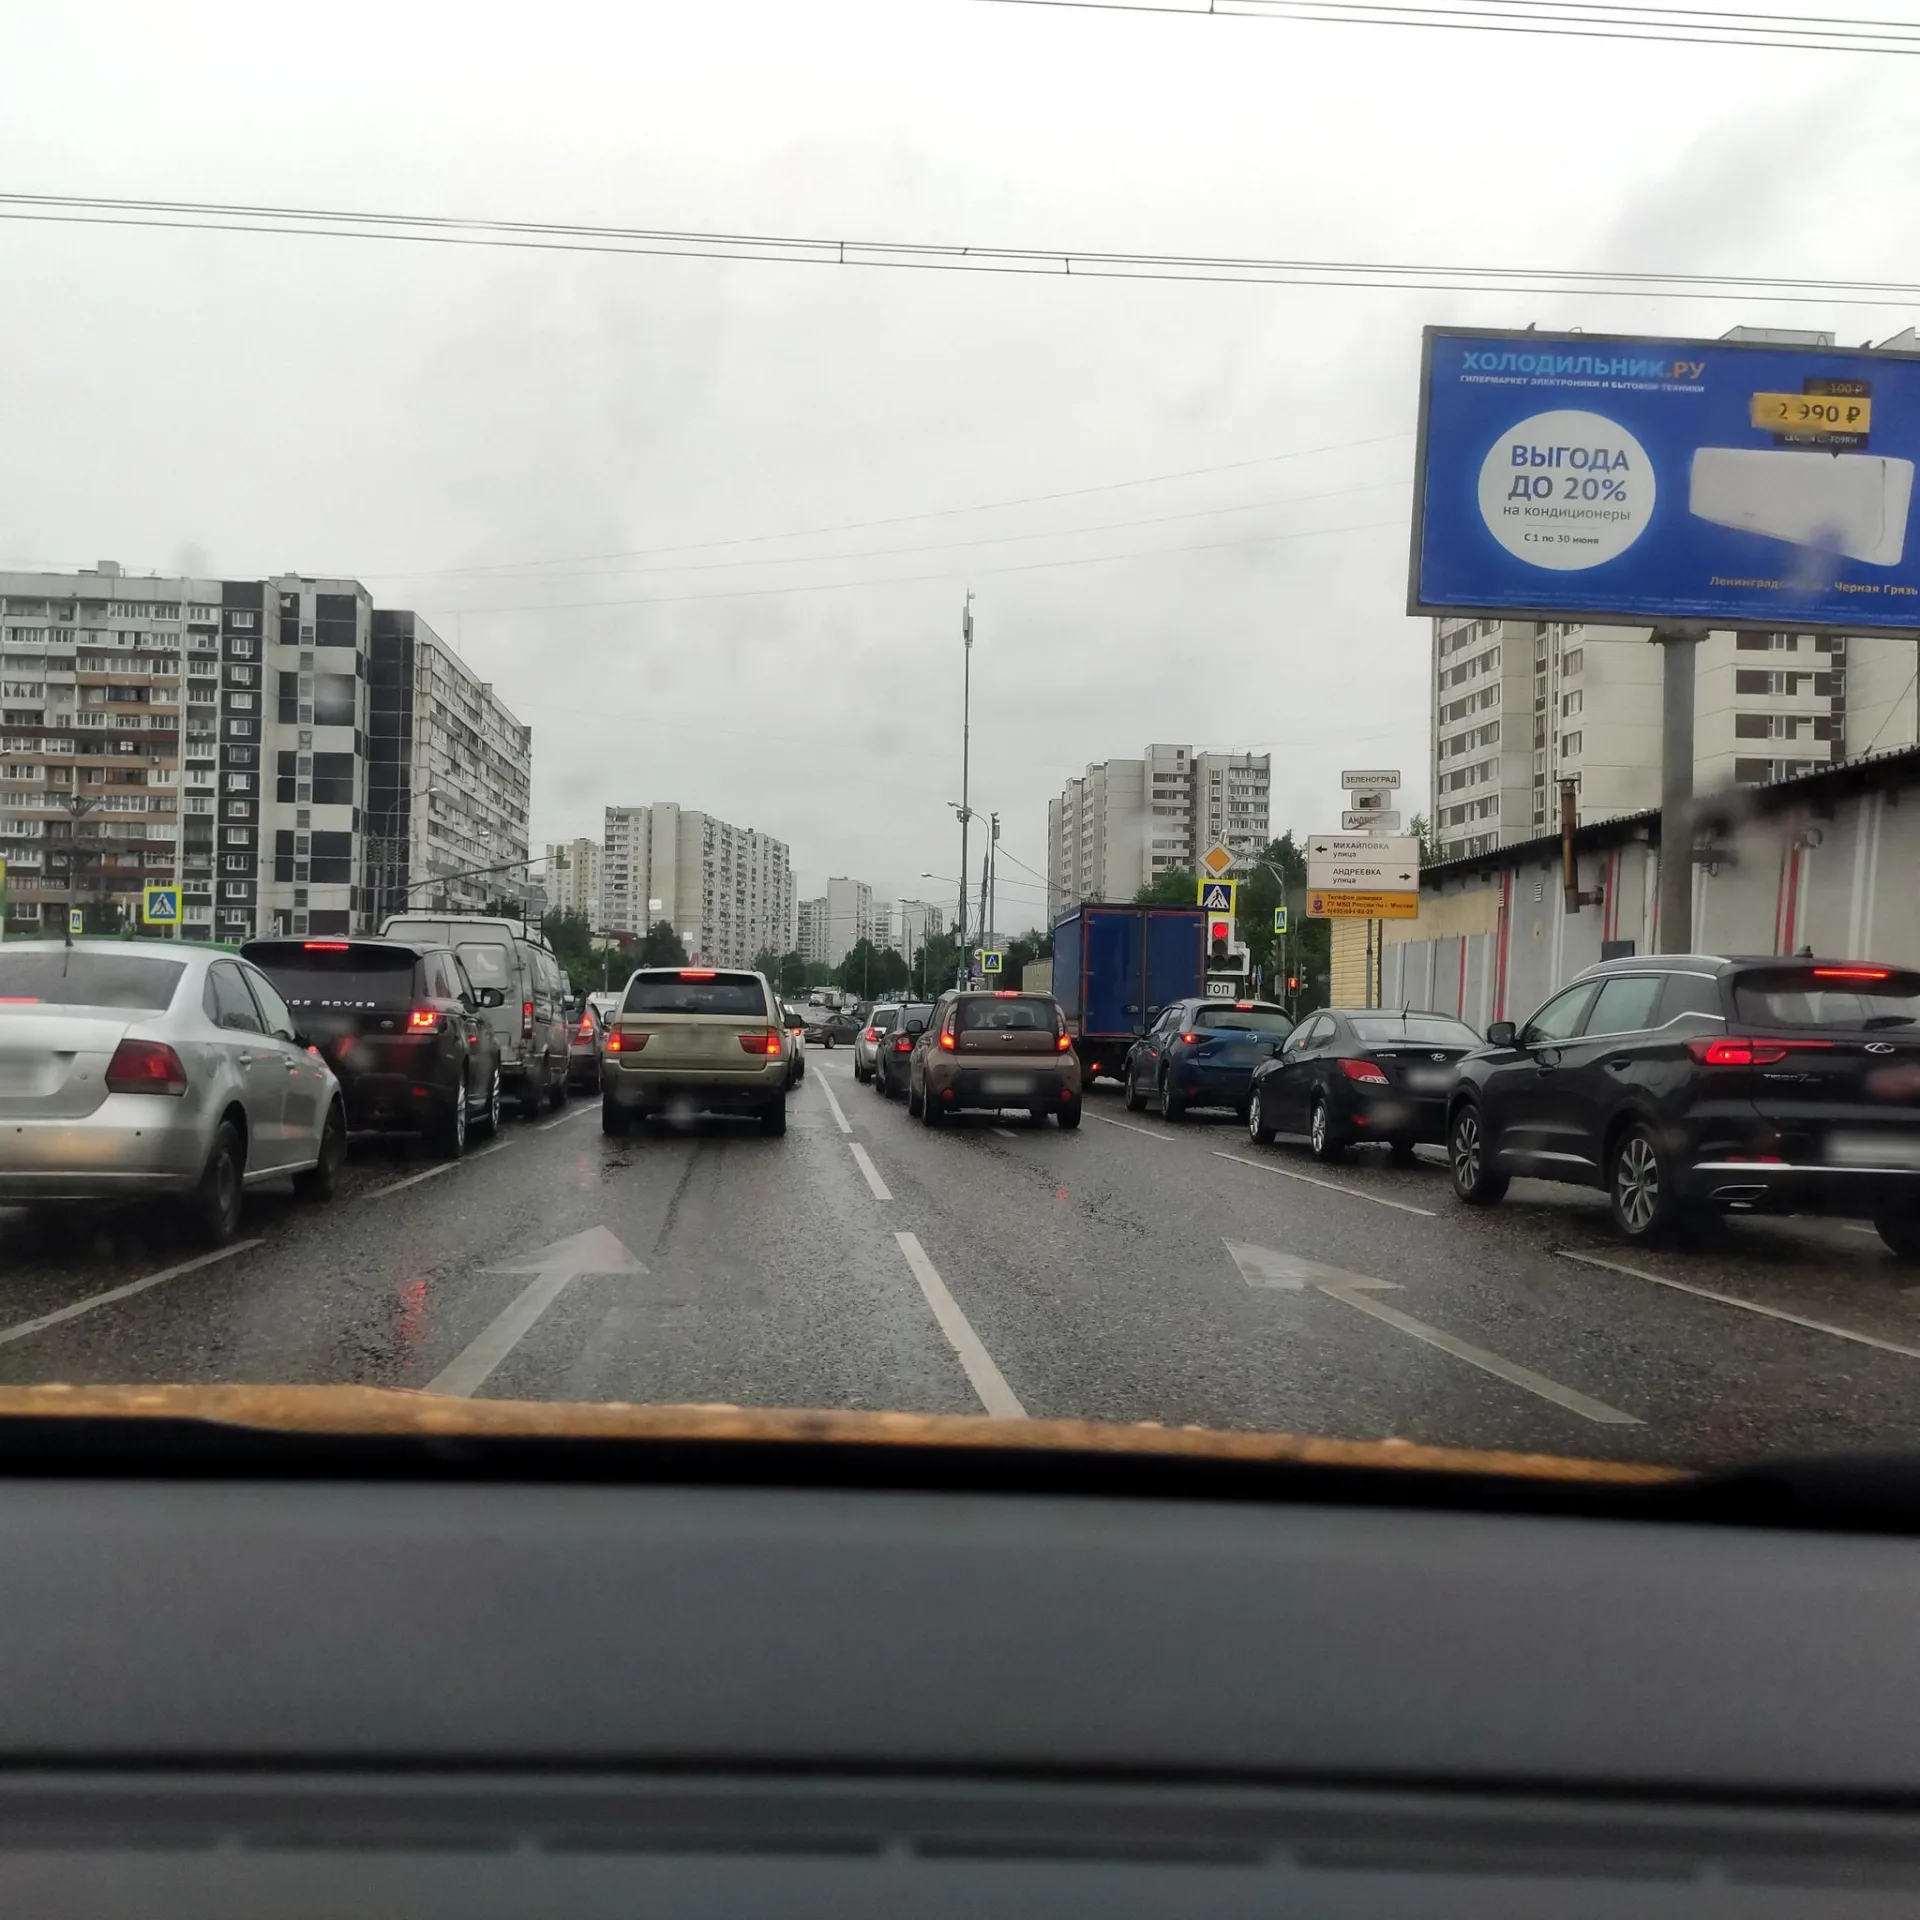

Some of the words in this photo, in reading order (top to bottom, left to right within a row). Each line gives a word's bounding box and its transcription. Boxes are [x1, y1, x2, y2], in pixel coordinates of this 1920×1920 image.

[1463, 352, 1706, 380] ХОЛОДИЛЬНИК.РУ
[1460, 375, 1528, 385] ГИПЕРМАРКЕТ
[1531, 378, 1600, 388] ЭЛЕКТРОНИКИ
[1602, 380, 1609, 388] И
[1799, 404, 1839, 423] 990
[1511, 444, 1630, 473] ВЫГОДА
[1508, 475, 1553, 501] ДО
[1563, 477, 1627, 502] 20%
[1503, 506, 1520, 516] на
[1524, 507, 1631, 522] кондиционеры
[1524, 533, 1531, 542] С
[1533, 533, 1539, 542] 1
[1542, 535, 1554, 543] по
[1557, 535, 1570, 543] 30
[1572, 537, 1599, 545] июня
[1834, 581, 1880, 594] Черная
[1884, 585, 1919, 596] Грязь
[1345, 776, 1397, 784] ЗЕЛЕНОГРАД
[1333, 842, 1390, 850] МИХАЙЛОВКА
[1332, 851, 1357, 859] улица
[1333, 868, 1382, 876] АНДРЕЕВКА
[1332, 877, 1357, 885] улица
[321, 1000, 376, 1008] ROVER
